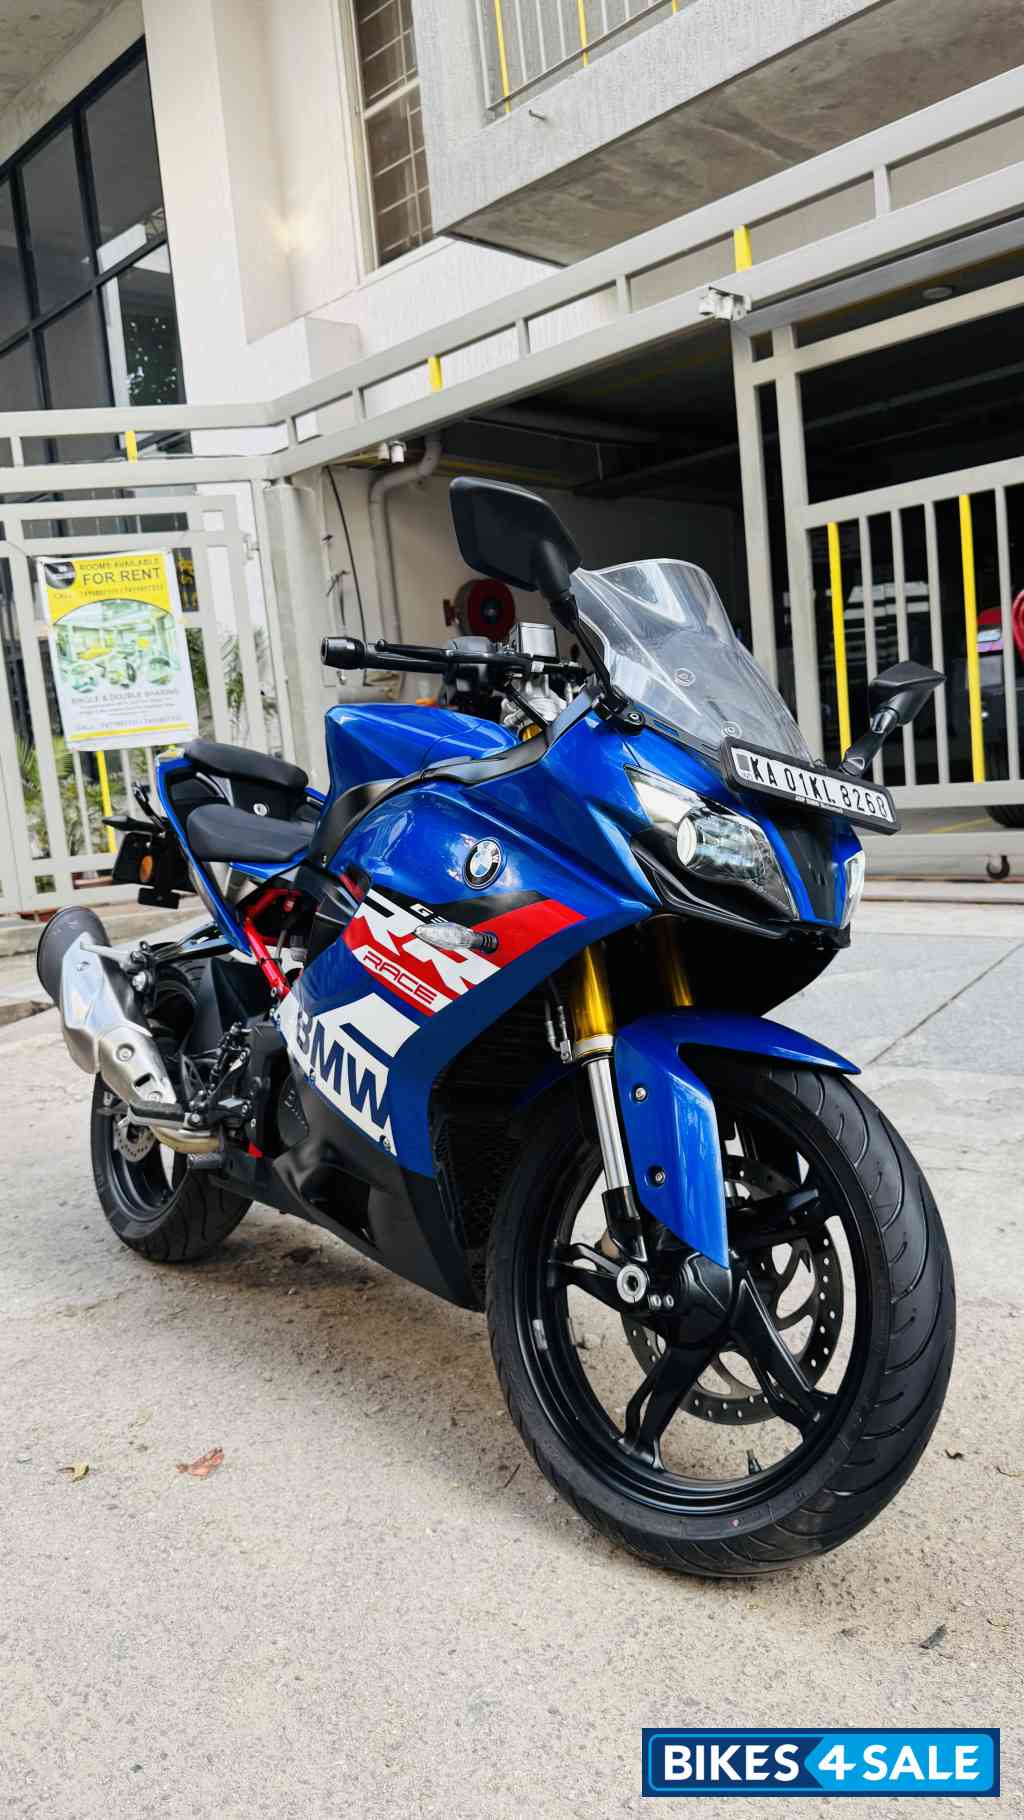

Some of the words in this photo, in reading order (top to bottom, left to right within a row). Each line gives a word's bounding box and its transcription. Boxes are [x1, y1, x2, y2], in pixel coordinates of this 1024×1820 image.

[83, 571, 116, 586] FOR
[120, 567, 160, 582] RENT
[750, 757, 778, 787] KA
[363, 950, 438, 1005] RACE
[297, 1010, 389, 1130] BMW
